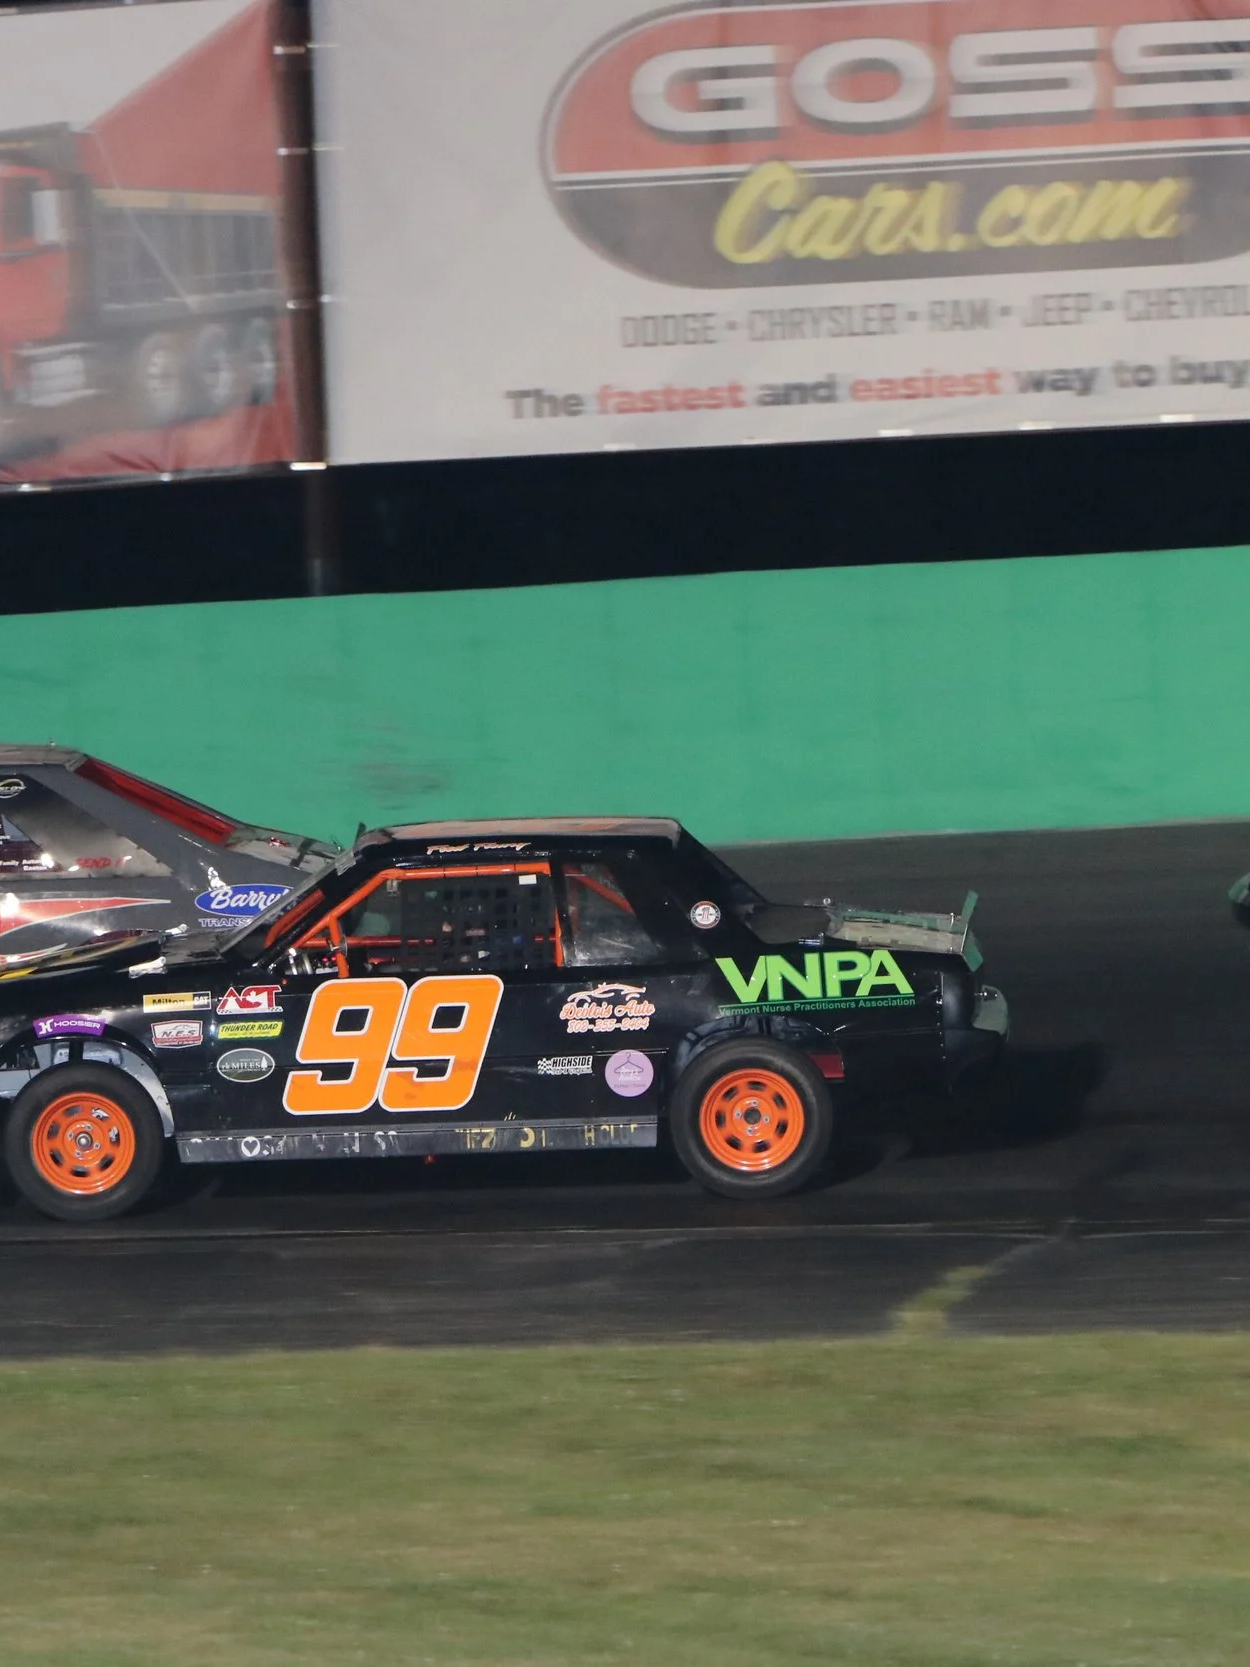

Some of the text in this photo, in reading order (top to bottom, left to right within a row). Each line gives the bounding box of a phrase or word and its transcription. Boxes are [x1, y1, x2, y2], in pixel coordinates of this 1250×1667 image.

[630, 18, 1250, 140] GOSS
[713, 159, 1185, 264] Cars.com
[621, 312, 717, 348] DODGE
[749, 302, 897, 342] CHRYSLER
[928, 299, 991, 332] RAM
[1022, 292, 1093, 327] JEEP
[505, 354, 1250, 419] The fastest and easiest way to buy
[715, 949, 915, 1003] VNPA
[152, 997, 186, 1006] Milton
[193, 995, 209, 1006] CAT
[218, 985, 283, 1011] ACT
[718, 998, 916, 1017] Vermont Nurse Practitioners Association
[614, 1000, 655, 1016] Auto
[53, 1019, 101, 1029] HOOSIER
[221, 1023, 278, 1032] THUNDER ROAD
[283, 974, 505, 1116] 99
[231, 1062, 261, 1070] MILES
[551, 1056, 592, 1068] HIGHSIDE
